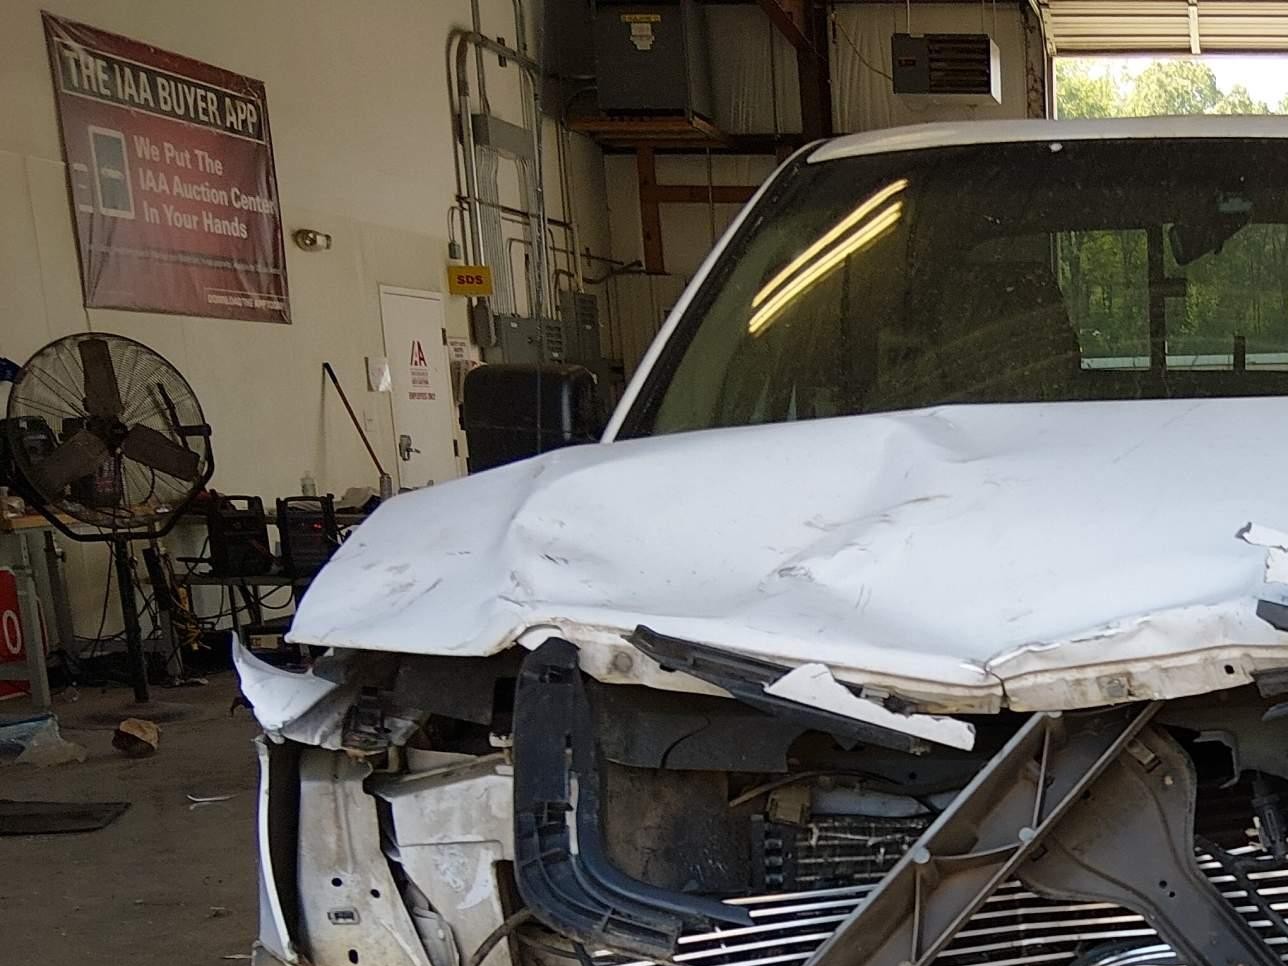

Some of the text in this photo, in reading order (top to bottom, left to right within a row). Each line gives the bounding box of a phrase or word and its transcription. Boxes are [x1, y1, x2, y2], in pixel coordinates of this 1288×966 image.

[63, 49, 258, 134] THE IAA BUYER APP
[134, 136, 224, 177] We Put The
[138, 167, 170, 195] IAA
[172, 175, 229, 207] Auction
[143, 200, 249, 240] In Your Hands
[456, 274, 484, 285] SDS
